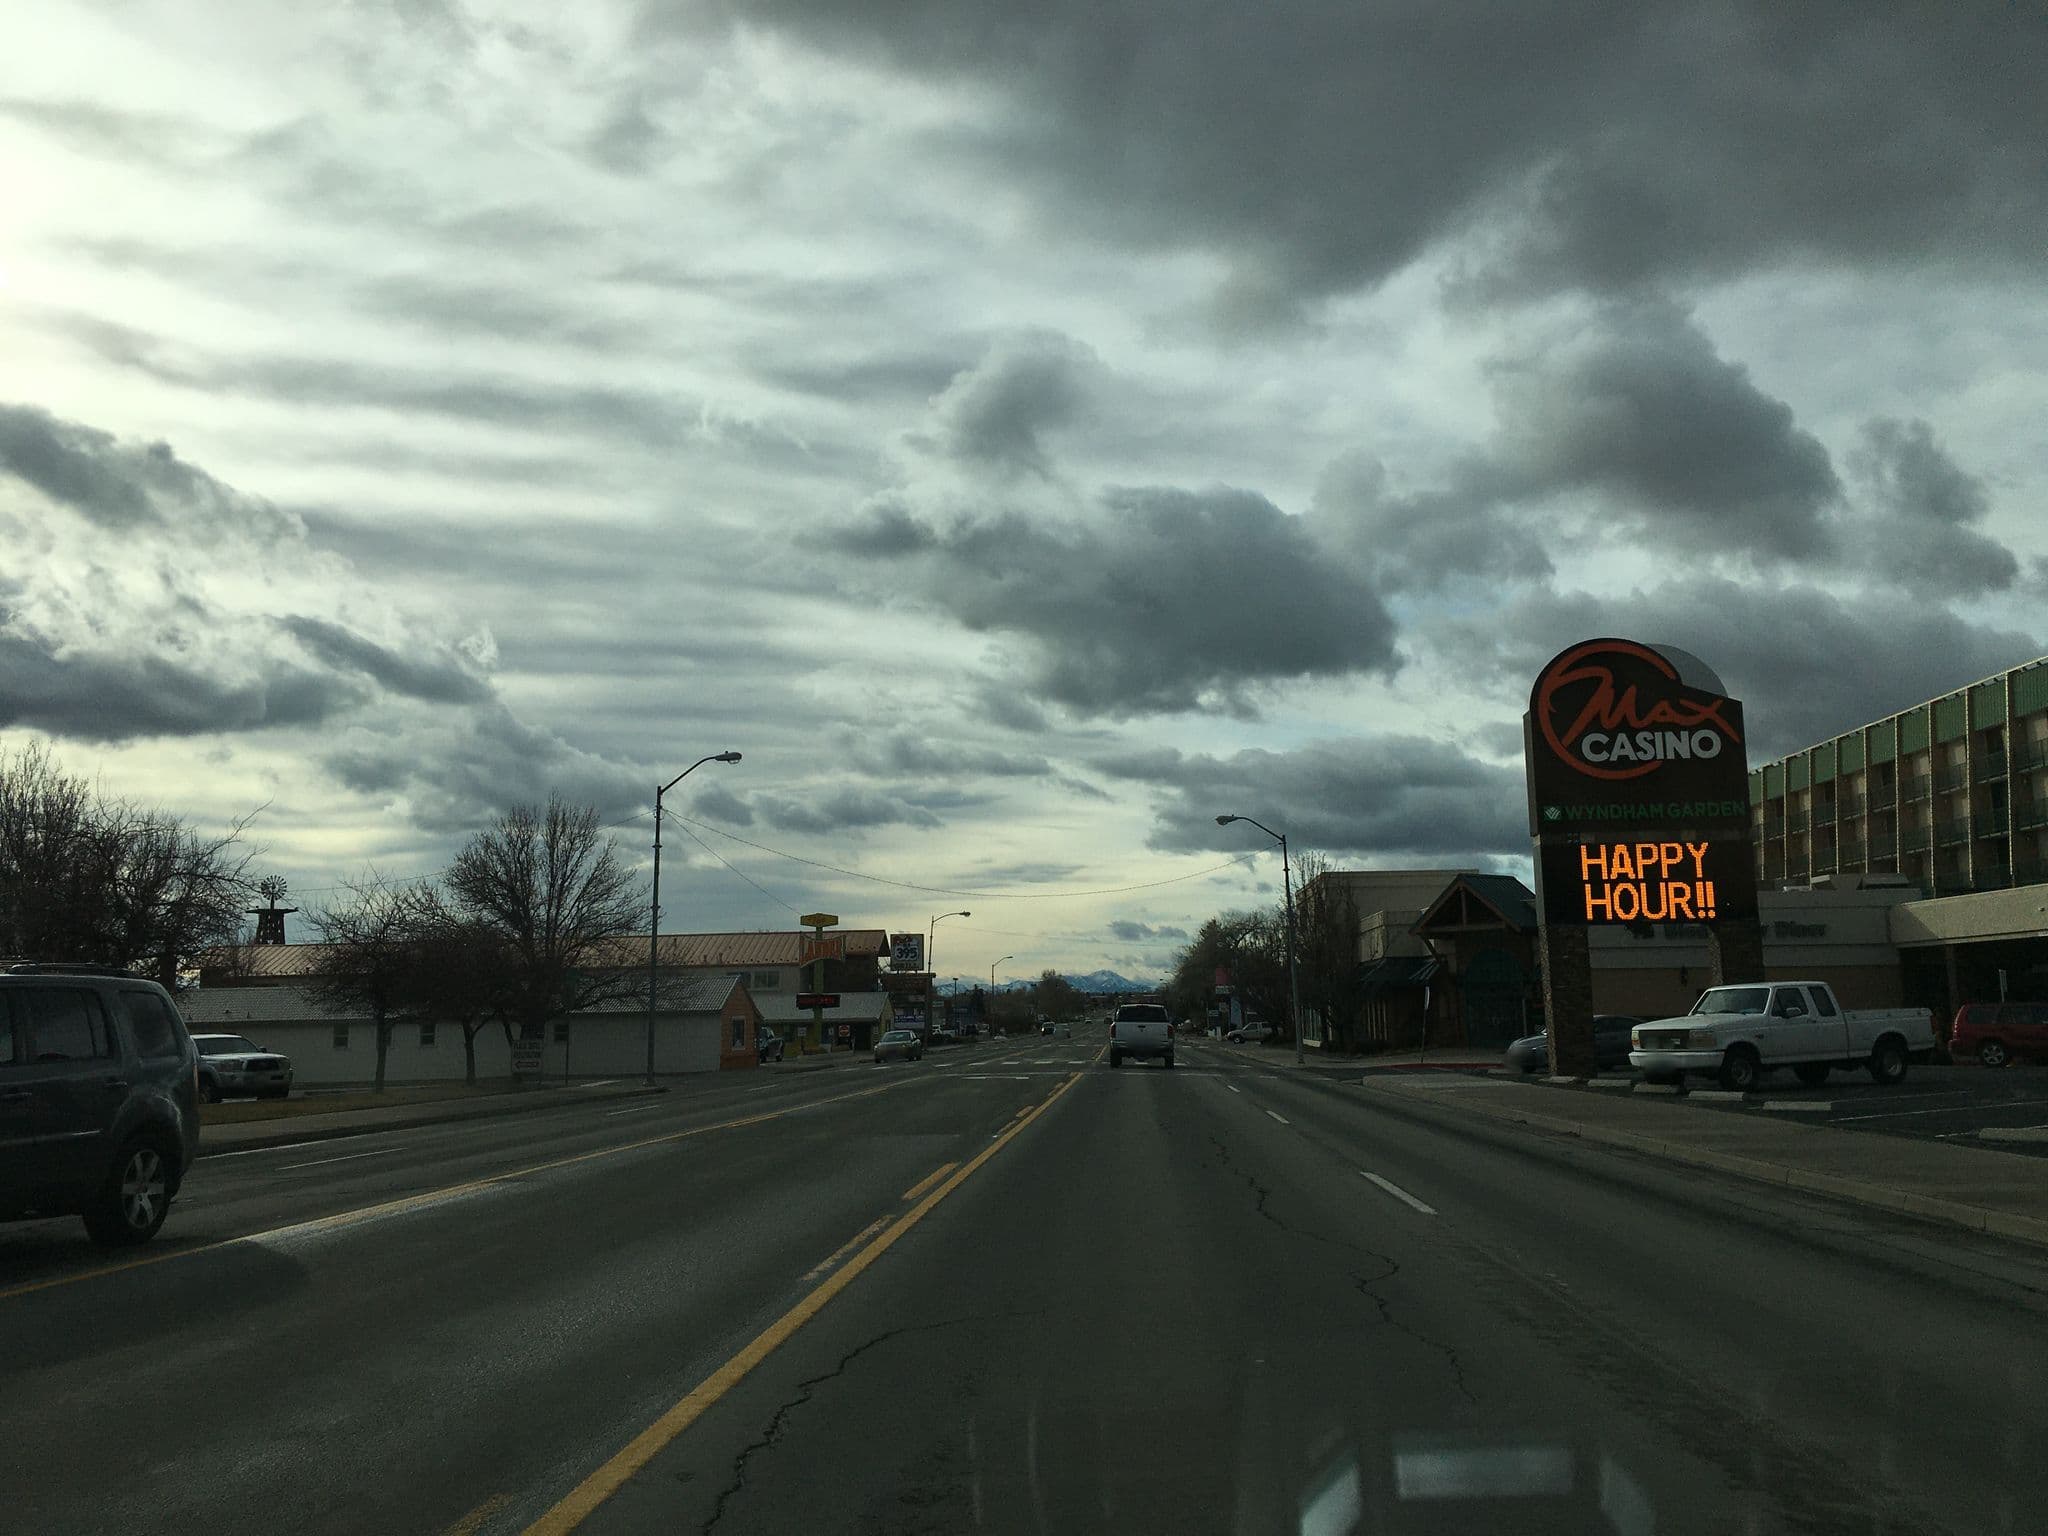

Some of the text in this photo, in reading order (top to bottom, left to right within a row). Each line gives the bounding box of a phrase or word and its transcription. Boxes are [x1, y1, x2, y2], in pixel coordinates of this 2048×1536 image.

[1554, 666, 1741, 746] Max
[1581, 729, 1722, 762] CASINO
[1567, 800, 1746, 821] WYNDHAM GARDEN
[1580, 842, 1709, 881] HAPPY
[1584, 881, 1717, 921] HOUR!!
[896, 947, 918, 959] 395
